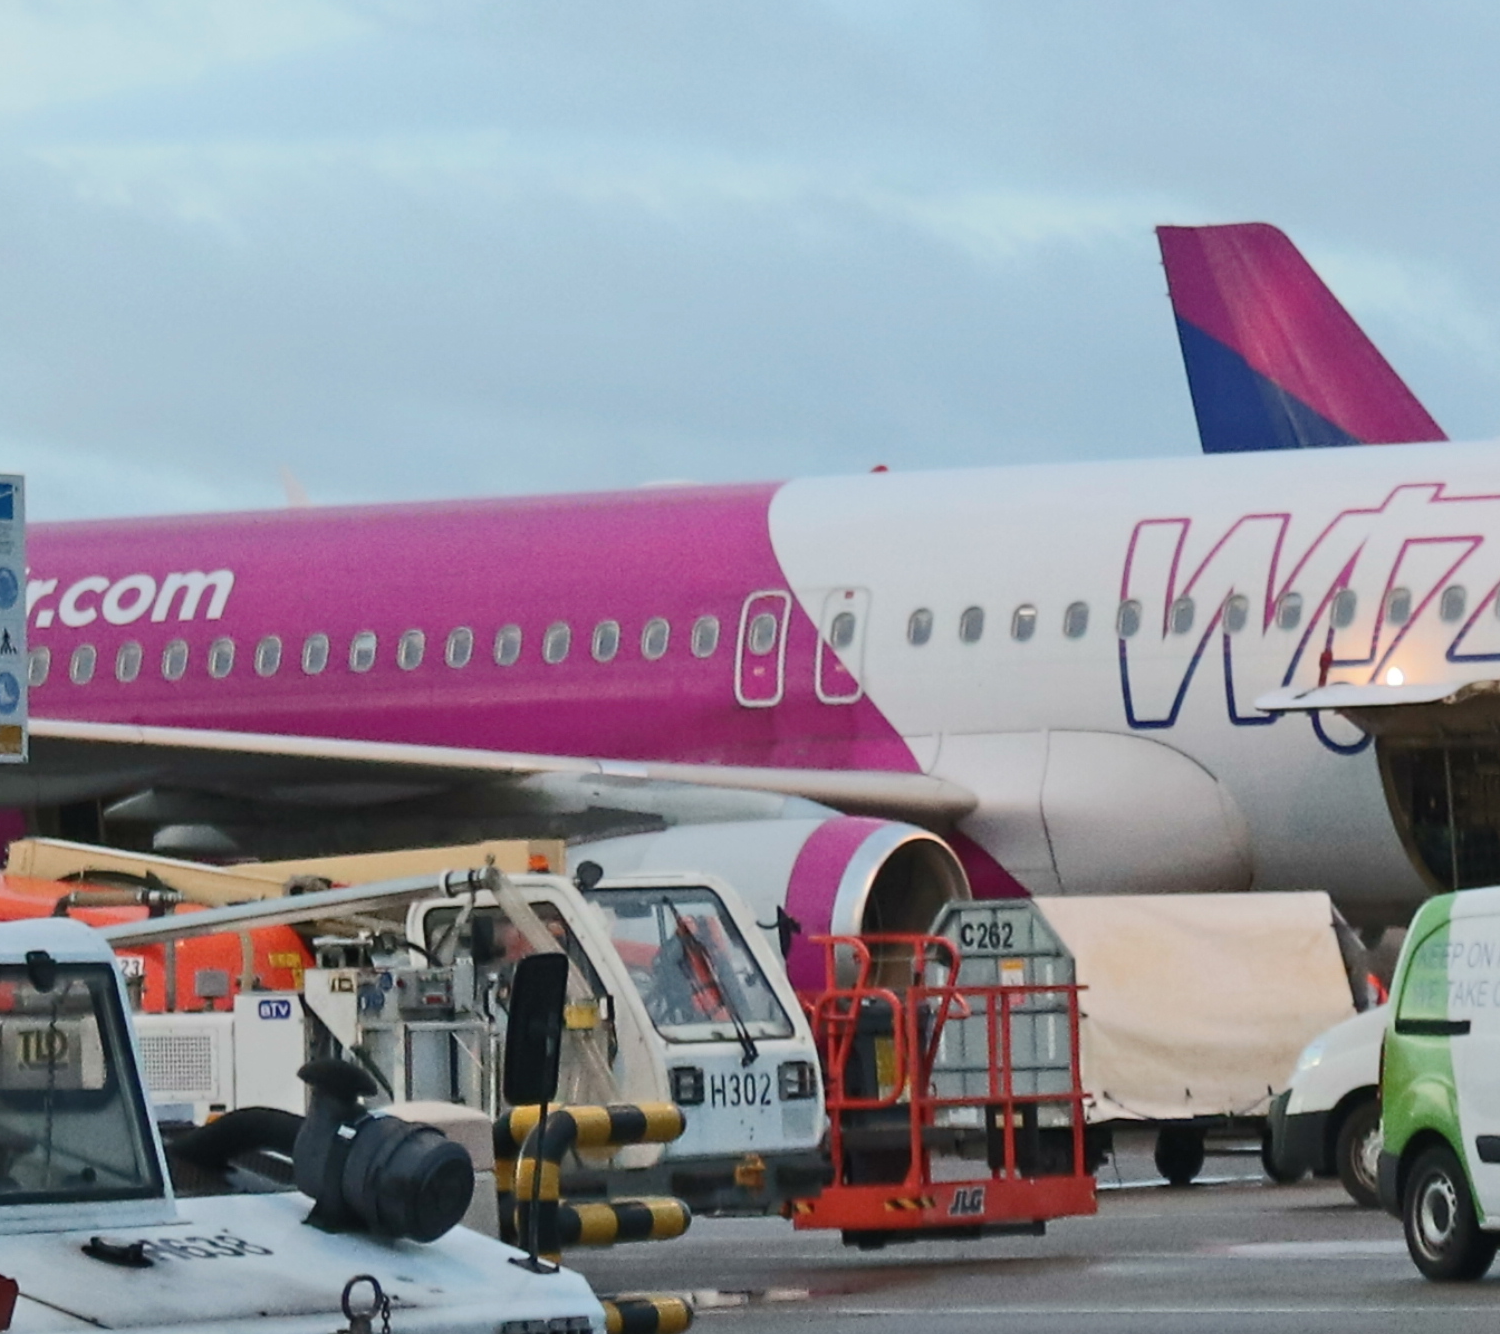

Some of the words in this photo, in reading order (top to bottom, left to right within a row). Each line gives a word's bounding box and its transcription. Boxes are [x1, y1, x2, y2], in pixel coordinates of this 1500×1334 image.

[25, 568, 235, 628] r.com
[960, 922, 1013, 949] C262
[1467, 941, 1496, 968] ON
[710, 1072, 772, 1108] H302
[951, 1188, 984, 1214] JLG
